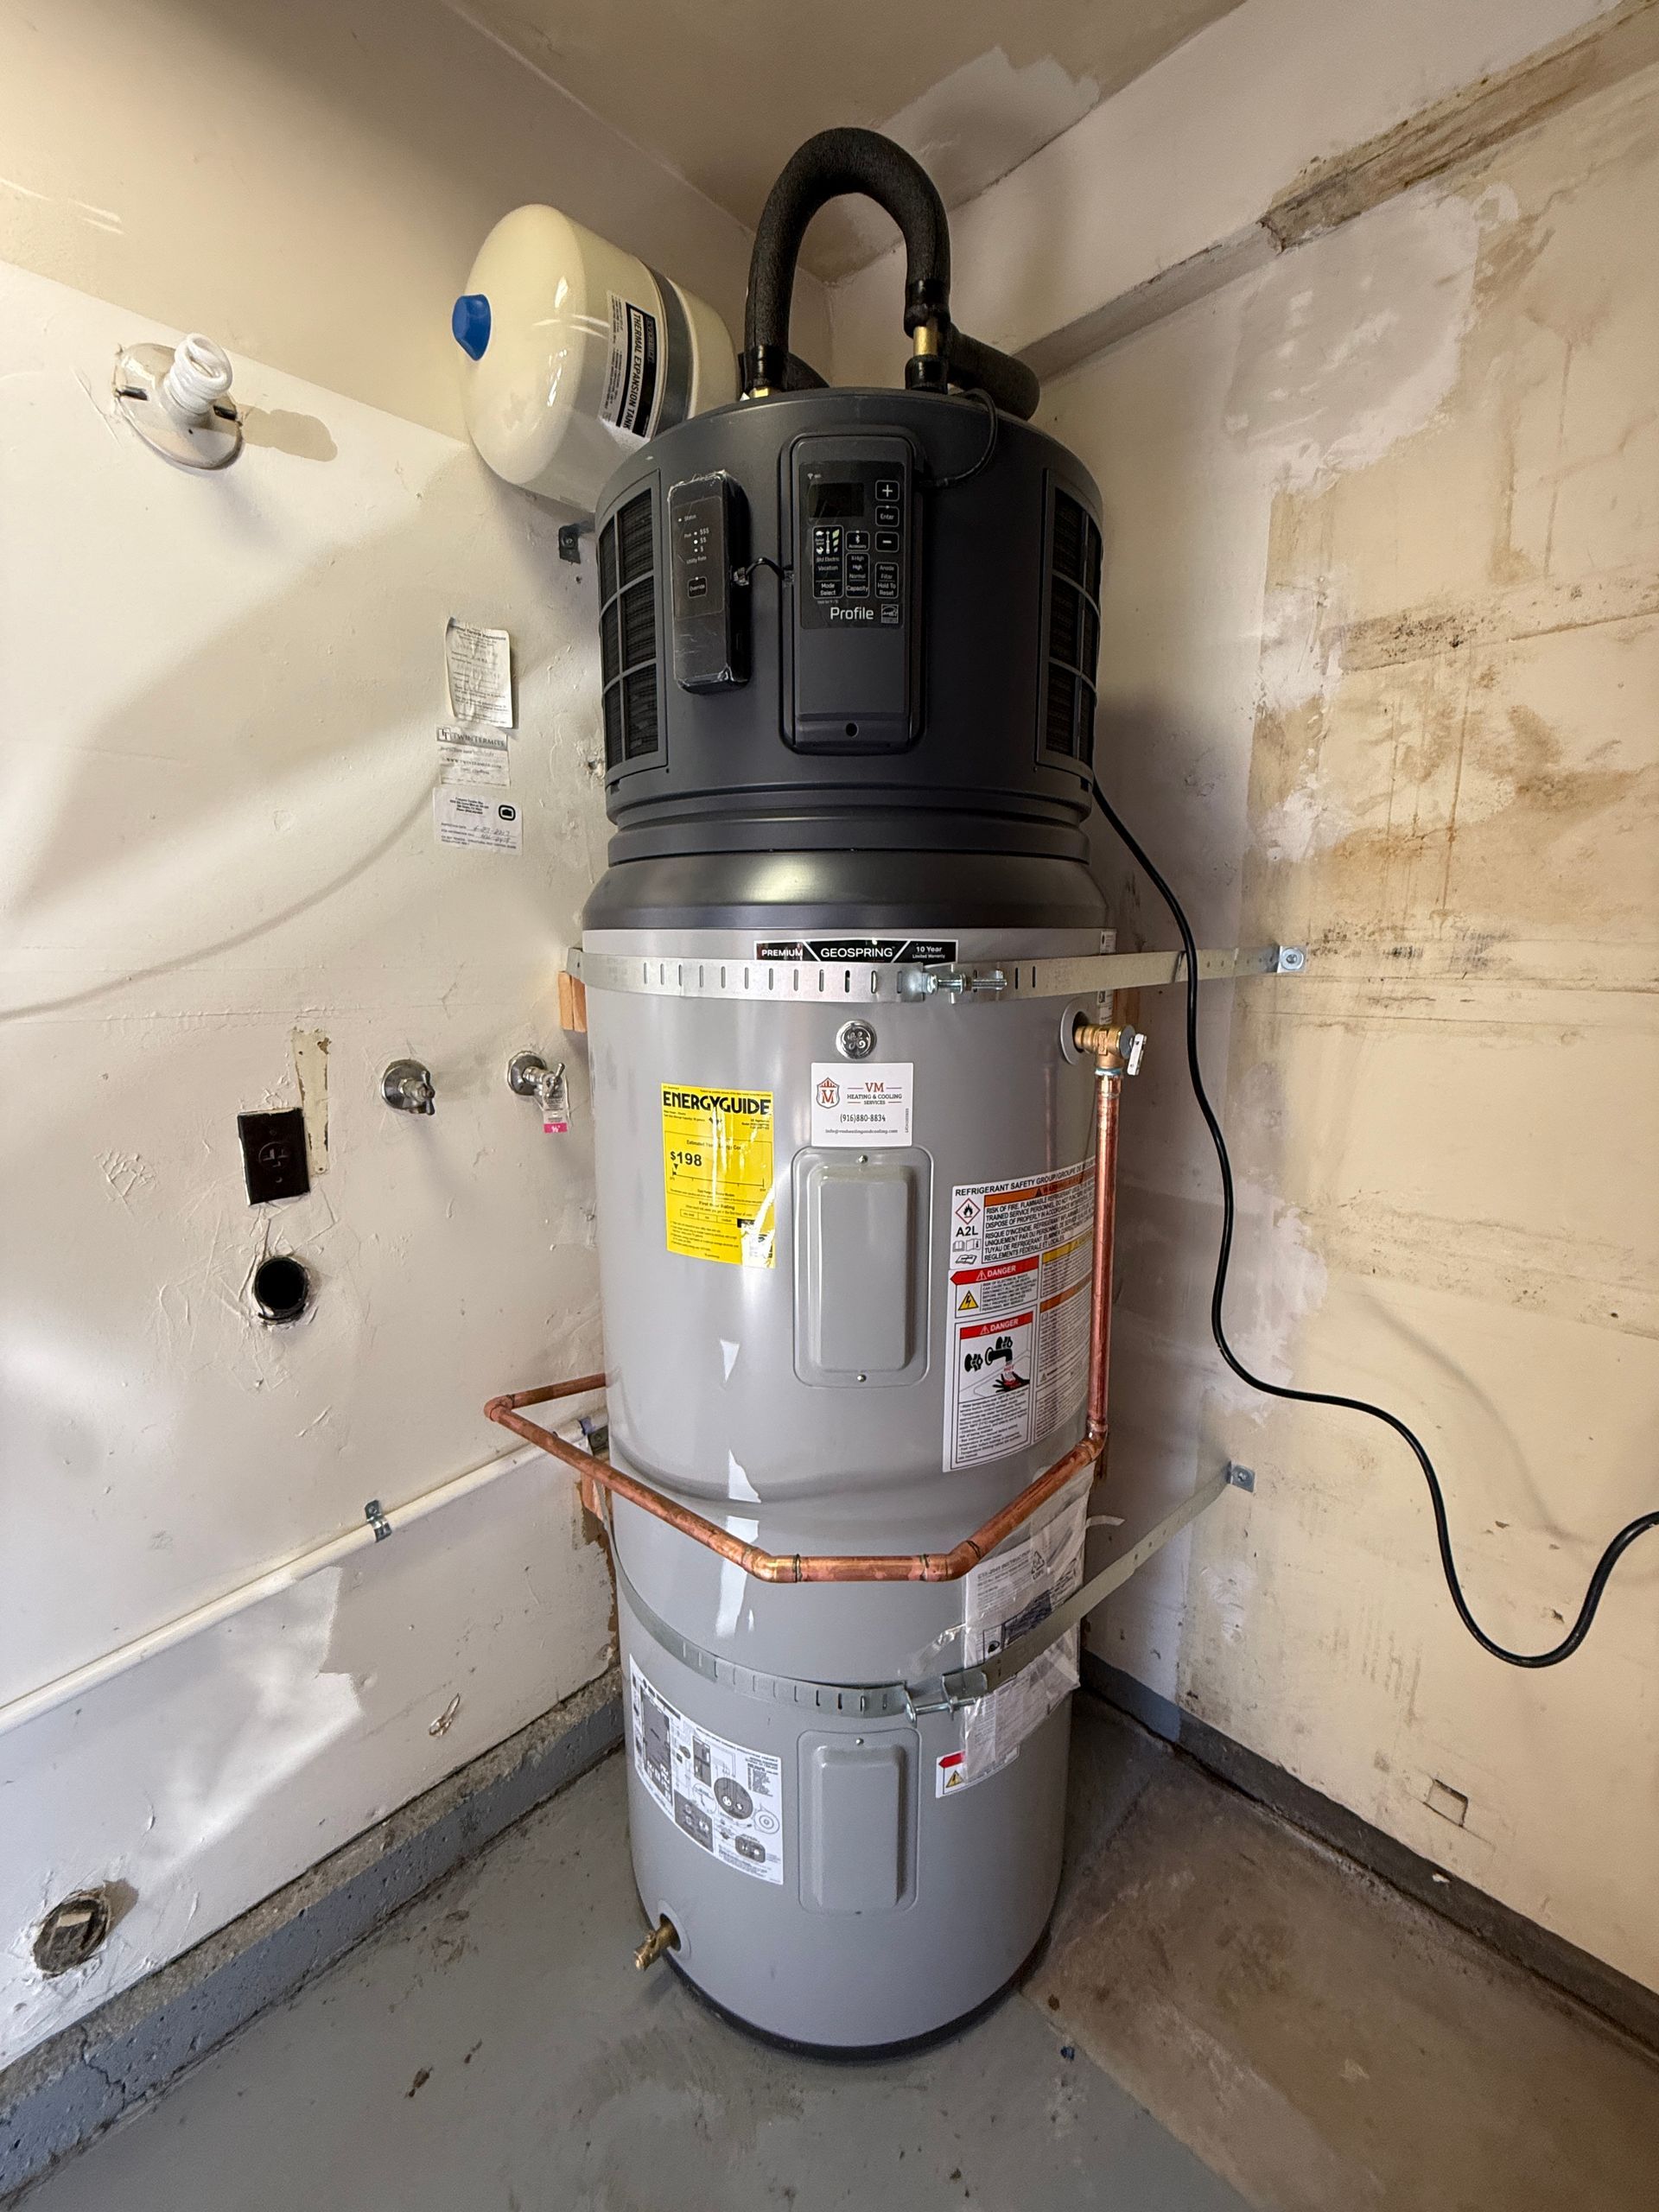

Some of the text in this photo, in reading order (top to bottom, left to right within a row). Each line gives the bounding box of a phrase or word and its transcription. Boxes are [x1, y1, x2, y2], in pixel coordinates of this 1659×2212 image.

[622, 313, 643, 429] THERMAL EXPANSION TANK
[830, 607, 874, 620] Profile
[761, 948, 804, 957] PREMIUM
[864, 1082, 885, 1092] VM
[663, 1090, 772, 1115] ENERGYGUIDE
[840, 1114, 886, 1123] (916)880-8834
[670, 1150, 702, 1166] $198
[955, 1183, 1010, 1197] REFRIGERANT
[1010, 1179, 1036, 1190] SAFETY
[1020, 1197, 1047, 1209] FLAMMABLE
[985, 1221, 1008, 1230] DISPOSE
[1017, 1212, 1040, 1224] PROPERLY
[986, 1212, 1009, 1223] TRAINED
[1009, 1209, 1030, 1218] SERVICE
[956, 1225, 978, 1237] A2L
[985, 1230, 1005, 1240] RISQUE
[985, 1235, 1018, 1247] UNIQUEMENT
[1019, 1232, 1028, 1241] PAR
[984, 1246, 1002, 1255] TUYAU
[987, 1265, 1016, 1278] DANGER
[989, 1319, 1019, 1332] DANGER
